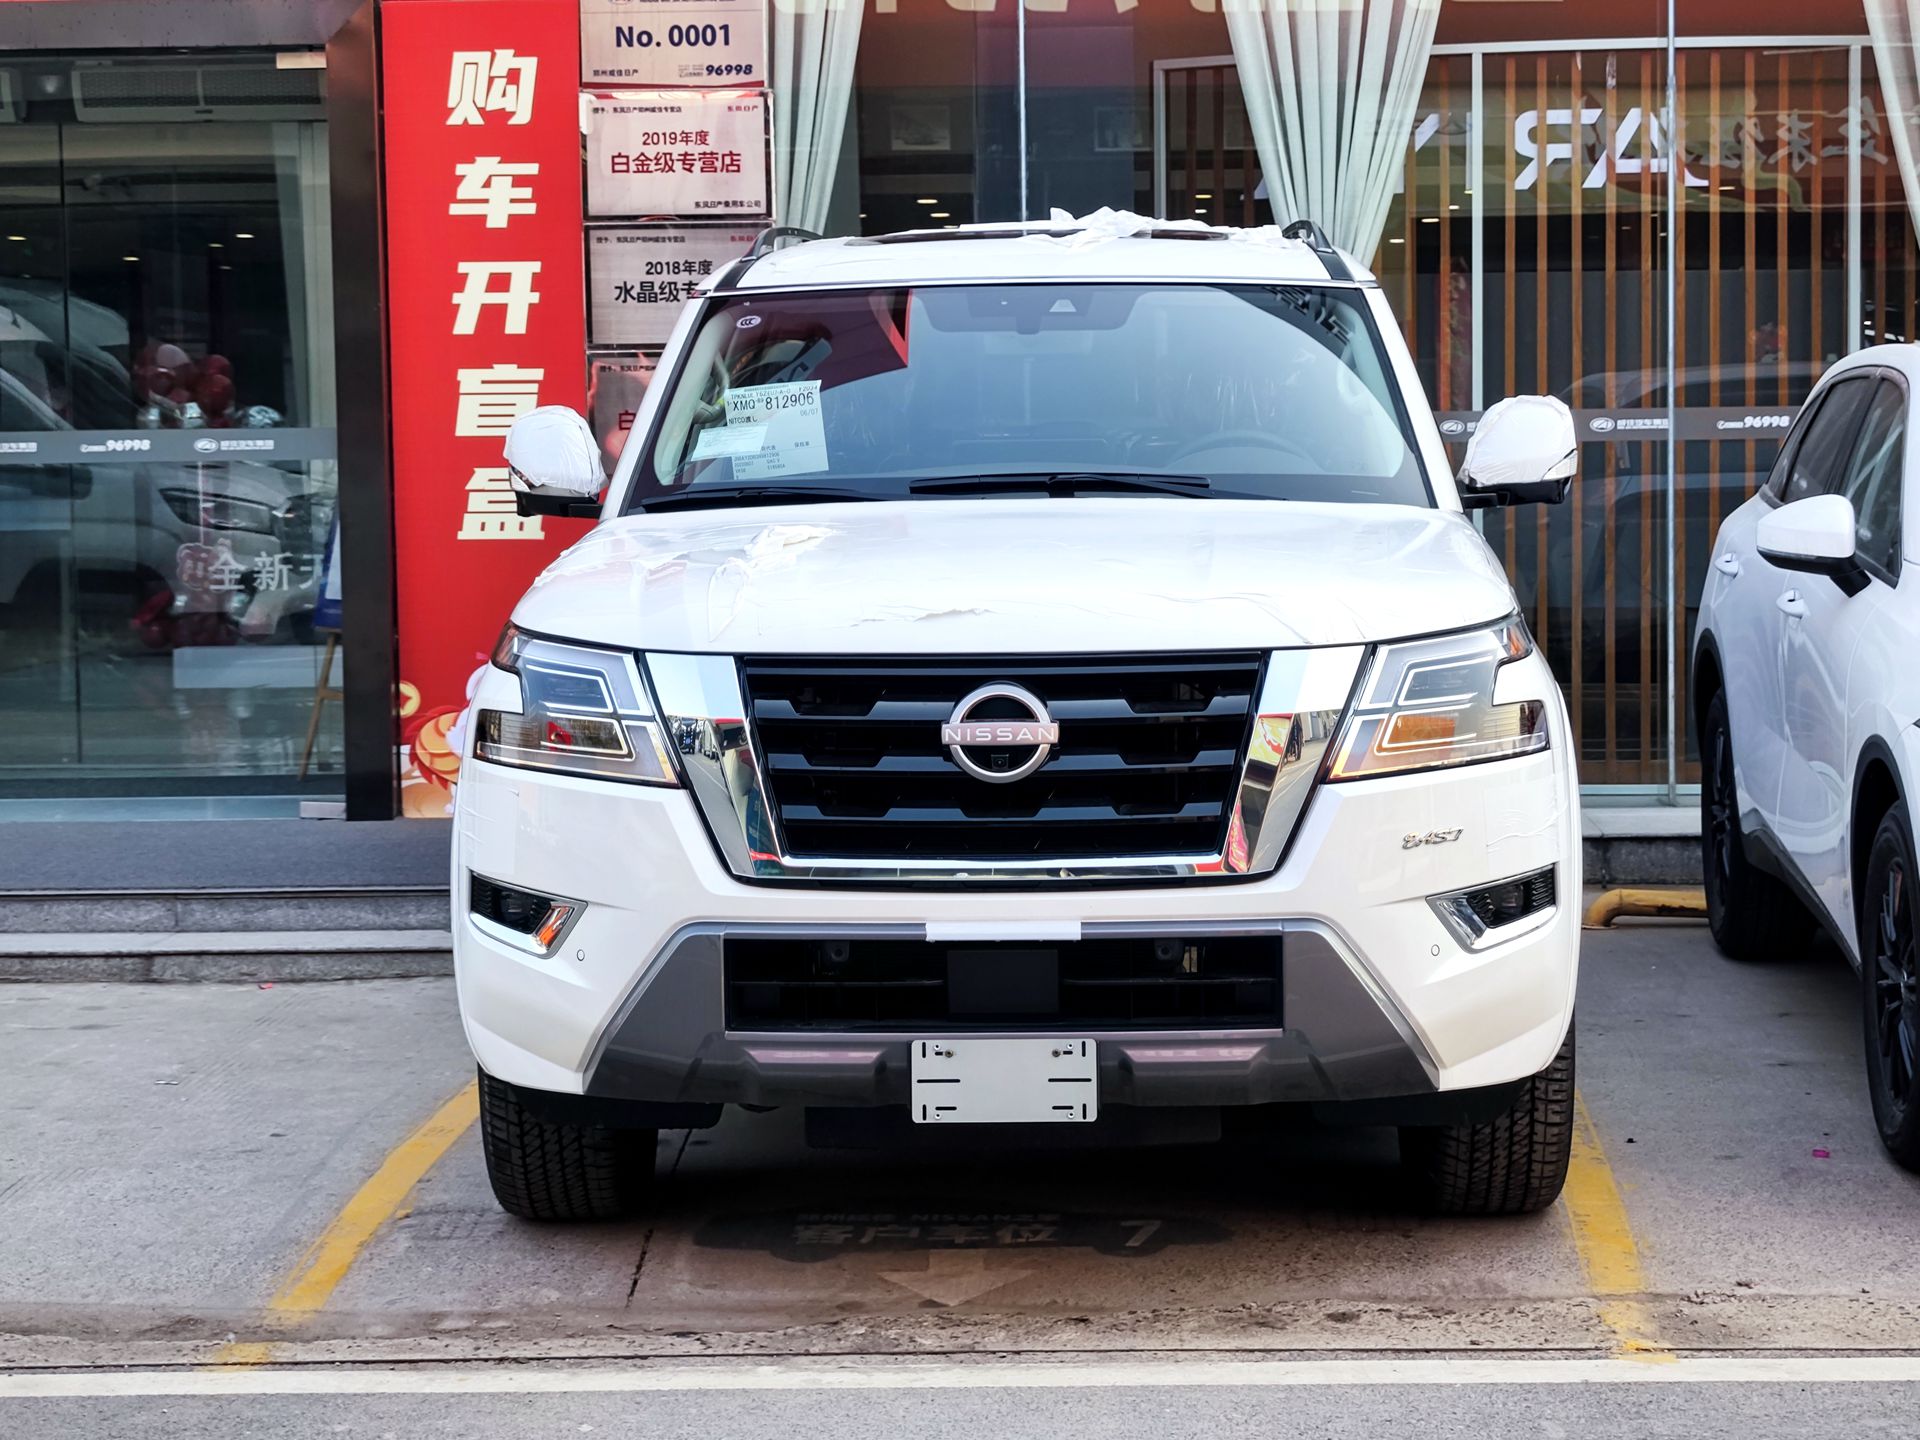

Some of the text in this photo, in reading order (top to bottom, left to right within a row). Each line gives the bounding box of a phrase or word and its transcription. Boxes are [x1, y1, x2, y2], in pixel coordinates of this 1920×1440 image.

[615, 24, 730, 47] No. 0001
[705, 64, 753, 76] 96998
[642, 130, 710, 146] 2019年度
[611, 151, 742, 174] 白金级专营店
[645, 259, 713, 275] 2018年度
[445, 48, 546, 540] 购车开盲盒
[765, 391, 814, 410] 812906
[1744, 415, 1790, 428] 96998
[106, 440, 150, 451] 96998
[945, 727, 1055, 742] NISSAN
[793, 1223, 1059, 1245] 客户车位
[1119, 1219, 1163, 1248] 7
